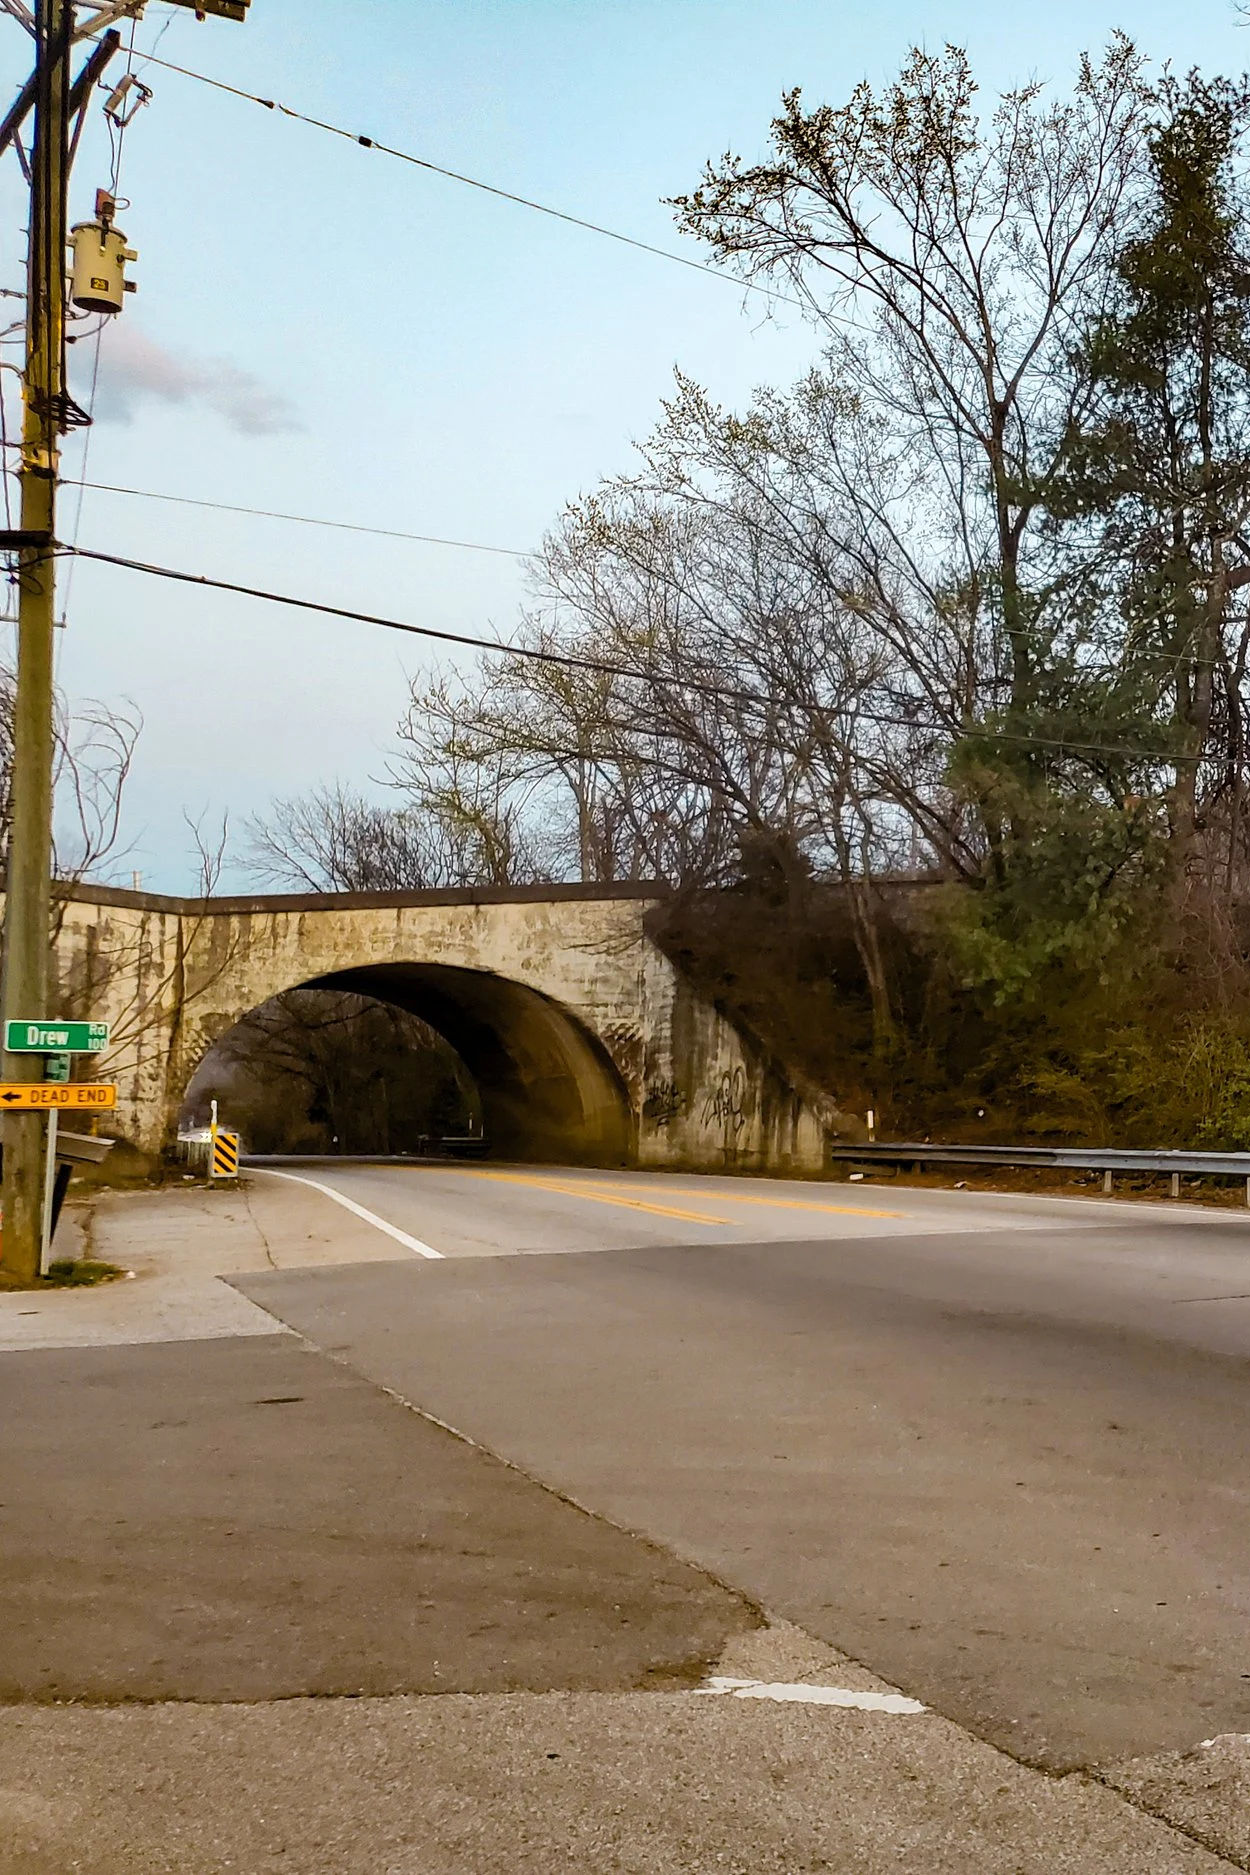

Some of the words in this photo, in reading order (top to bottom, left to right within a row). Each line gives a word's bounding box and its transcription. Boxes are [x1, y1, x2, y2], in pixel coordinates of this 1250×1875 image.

[27, 1026, 69, 1045] Drew
[89, 1024, 105, 1035] Rd
[88, 1038, 106, 1049] 100
[30, 1090, 69, 1103] DEAD
[78, 1090, 107, 1102] END
